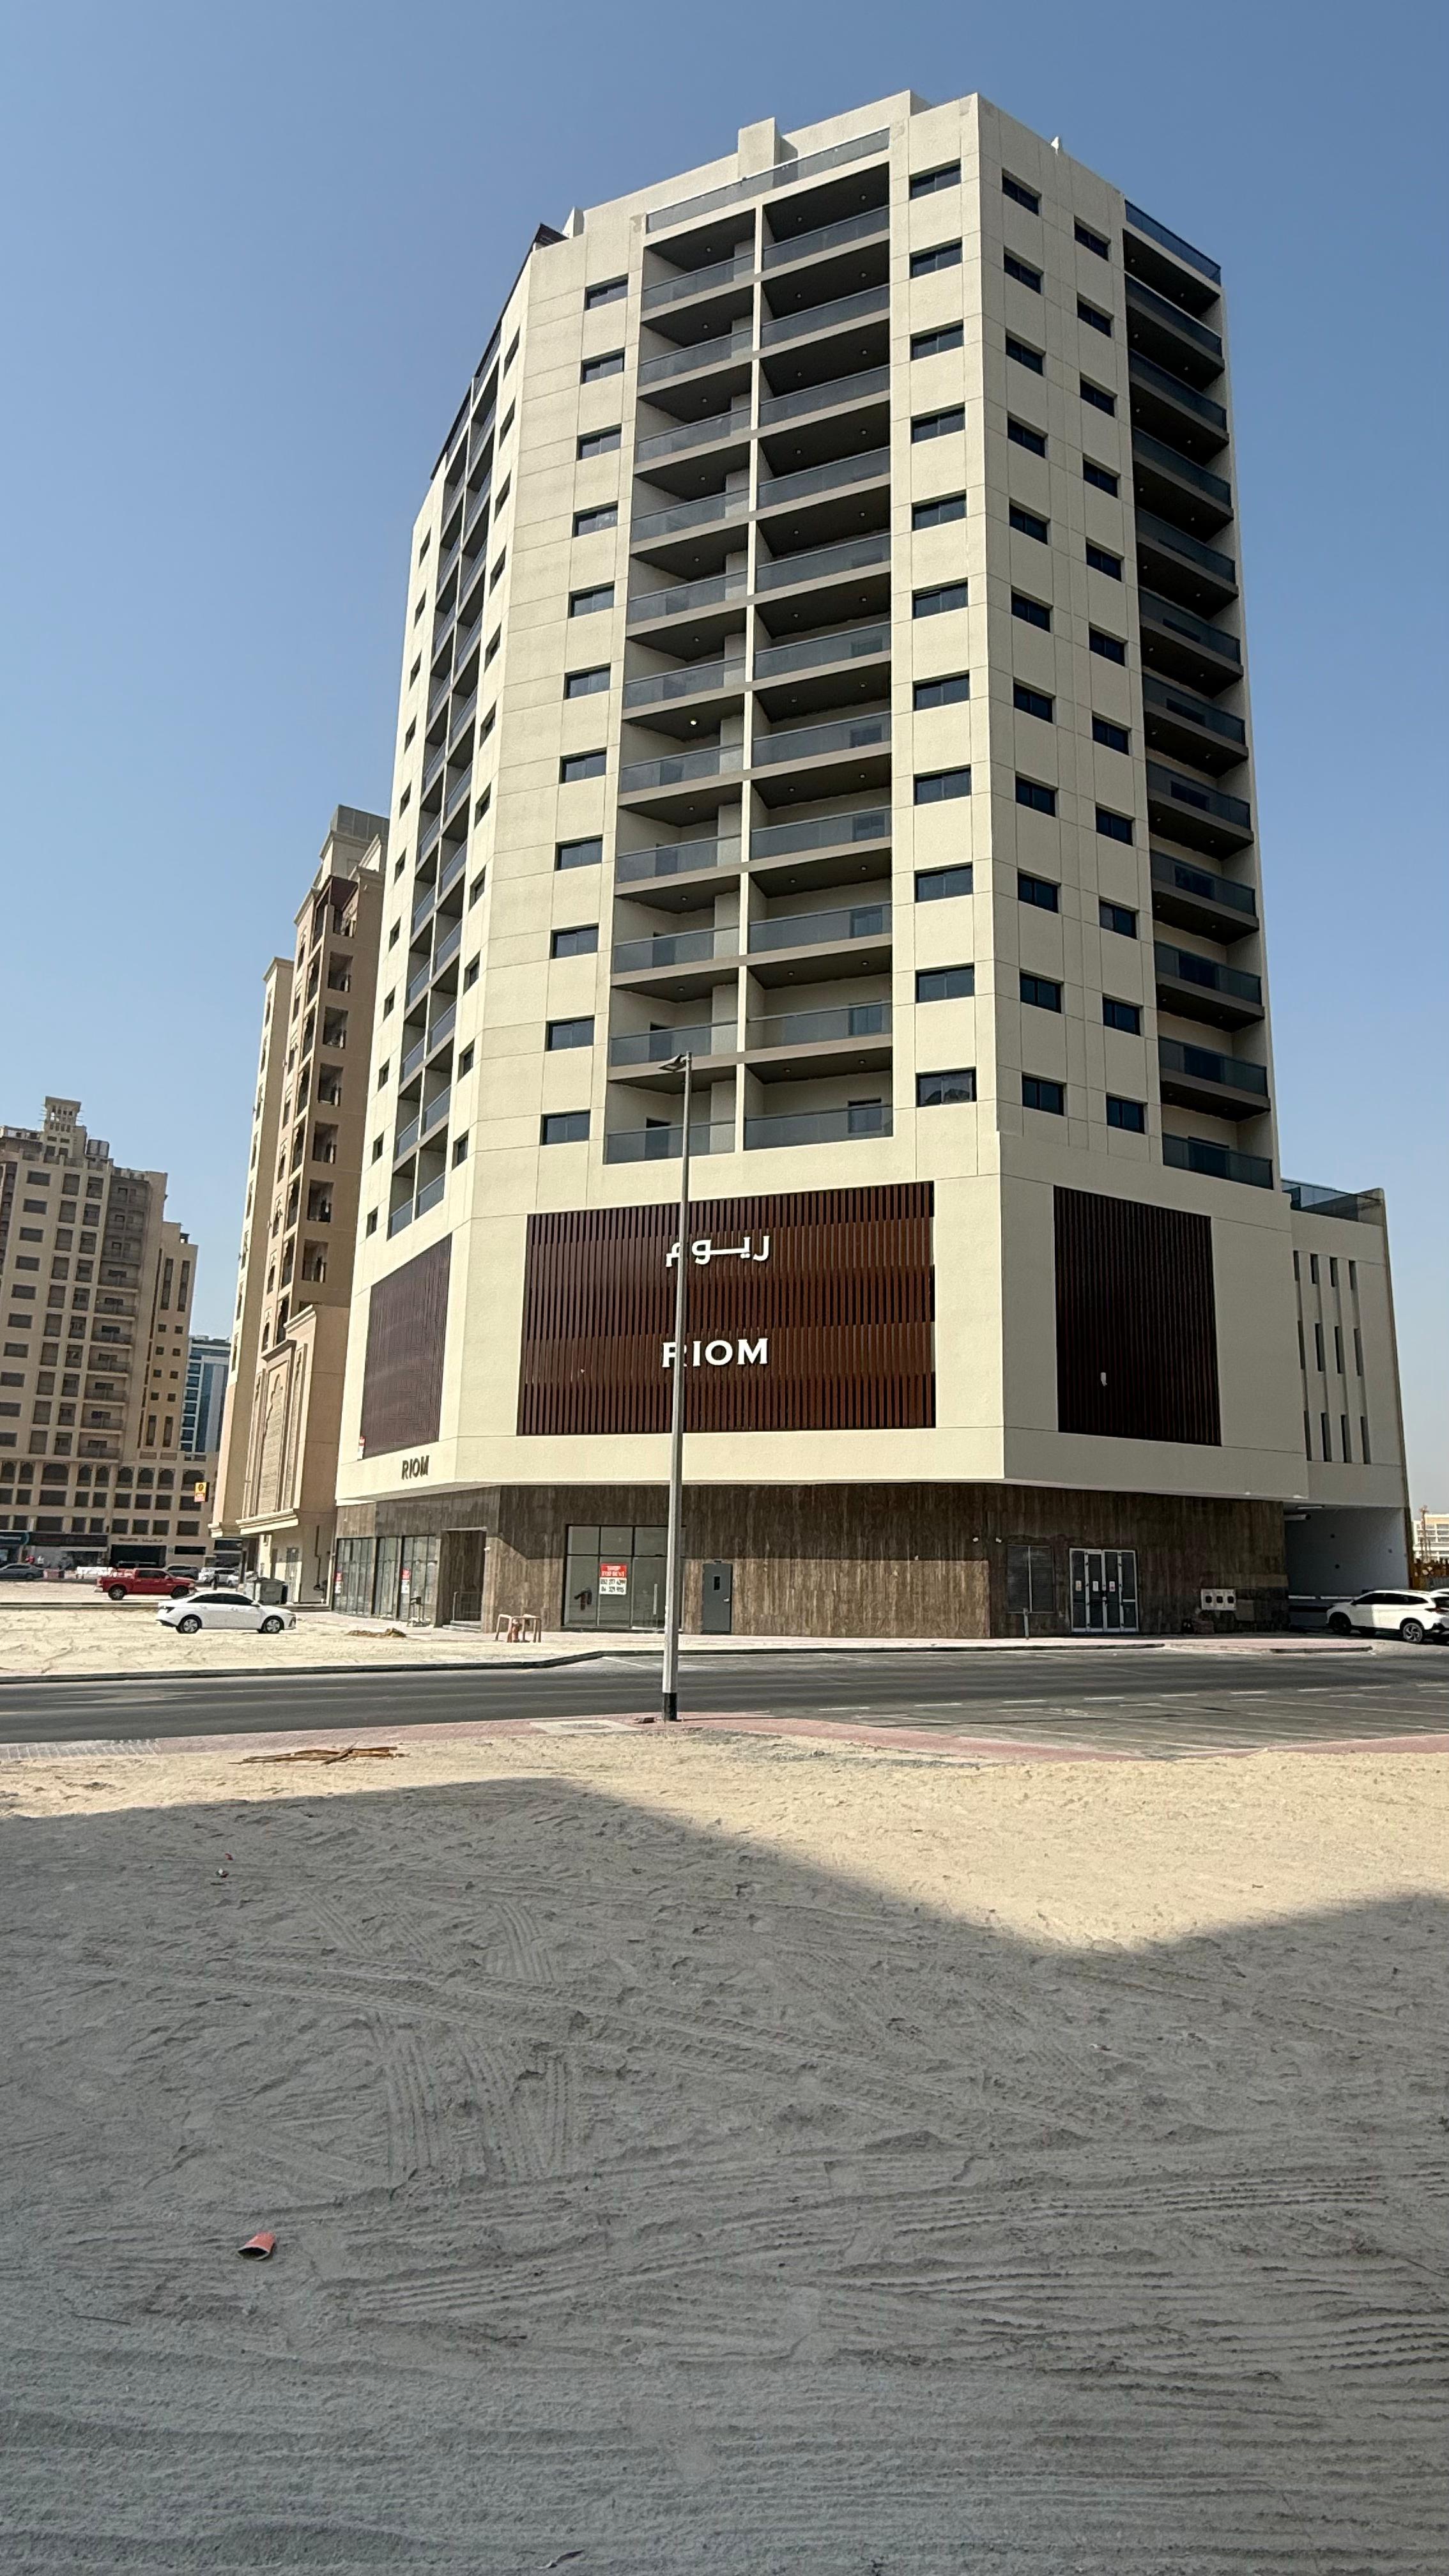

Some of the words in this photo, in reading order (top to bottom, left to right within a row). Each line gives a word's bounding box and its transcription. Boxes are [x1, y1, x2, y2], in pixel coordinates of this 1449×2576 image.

[665, 1236, 770, 1268] ريوم
[662, 1338, 769, 1368] RIOM
[401, 1455, 430, 1480] RIOM
